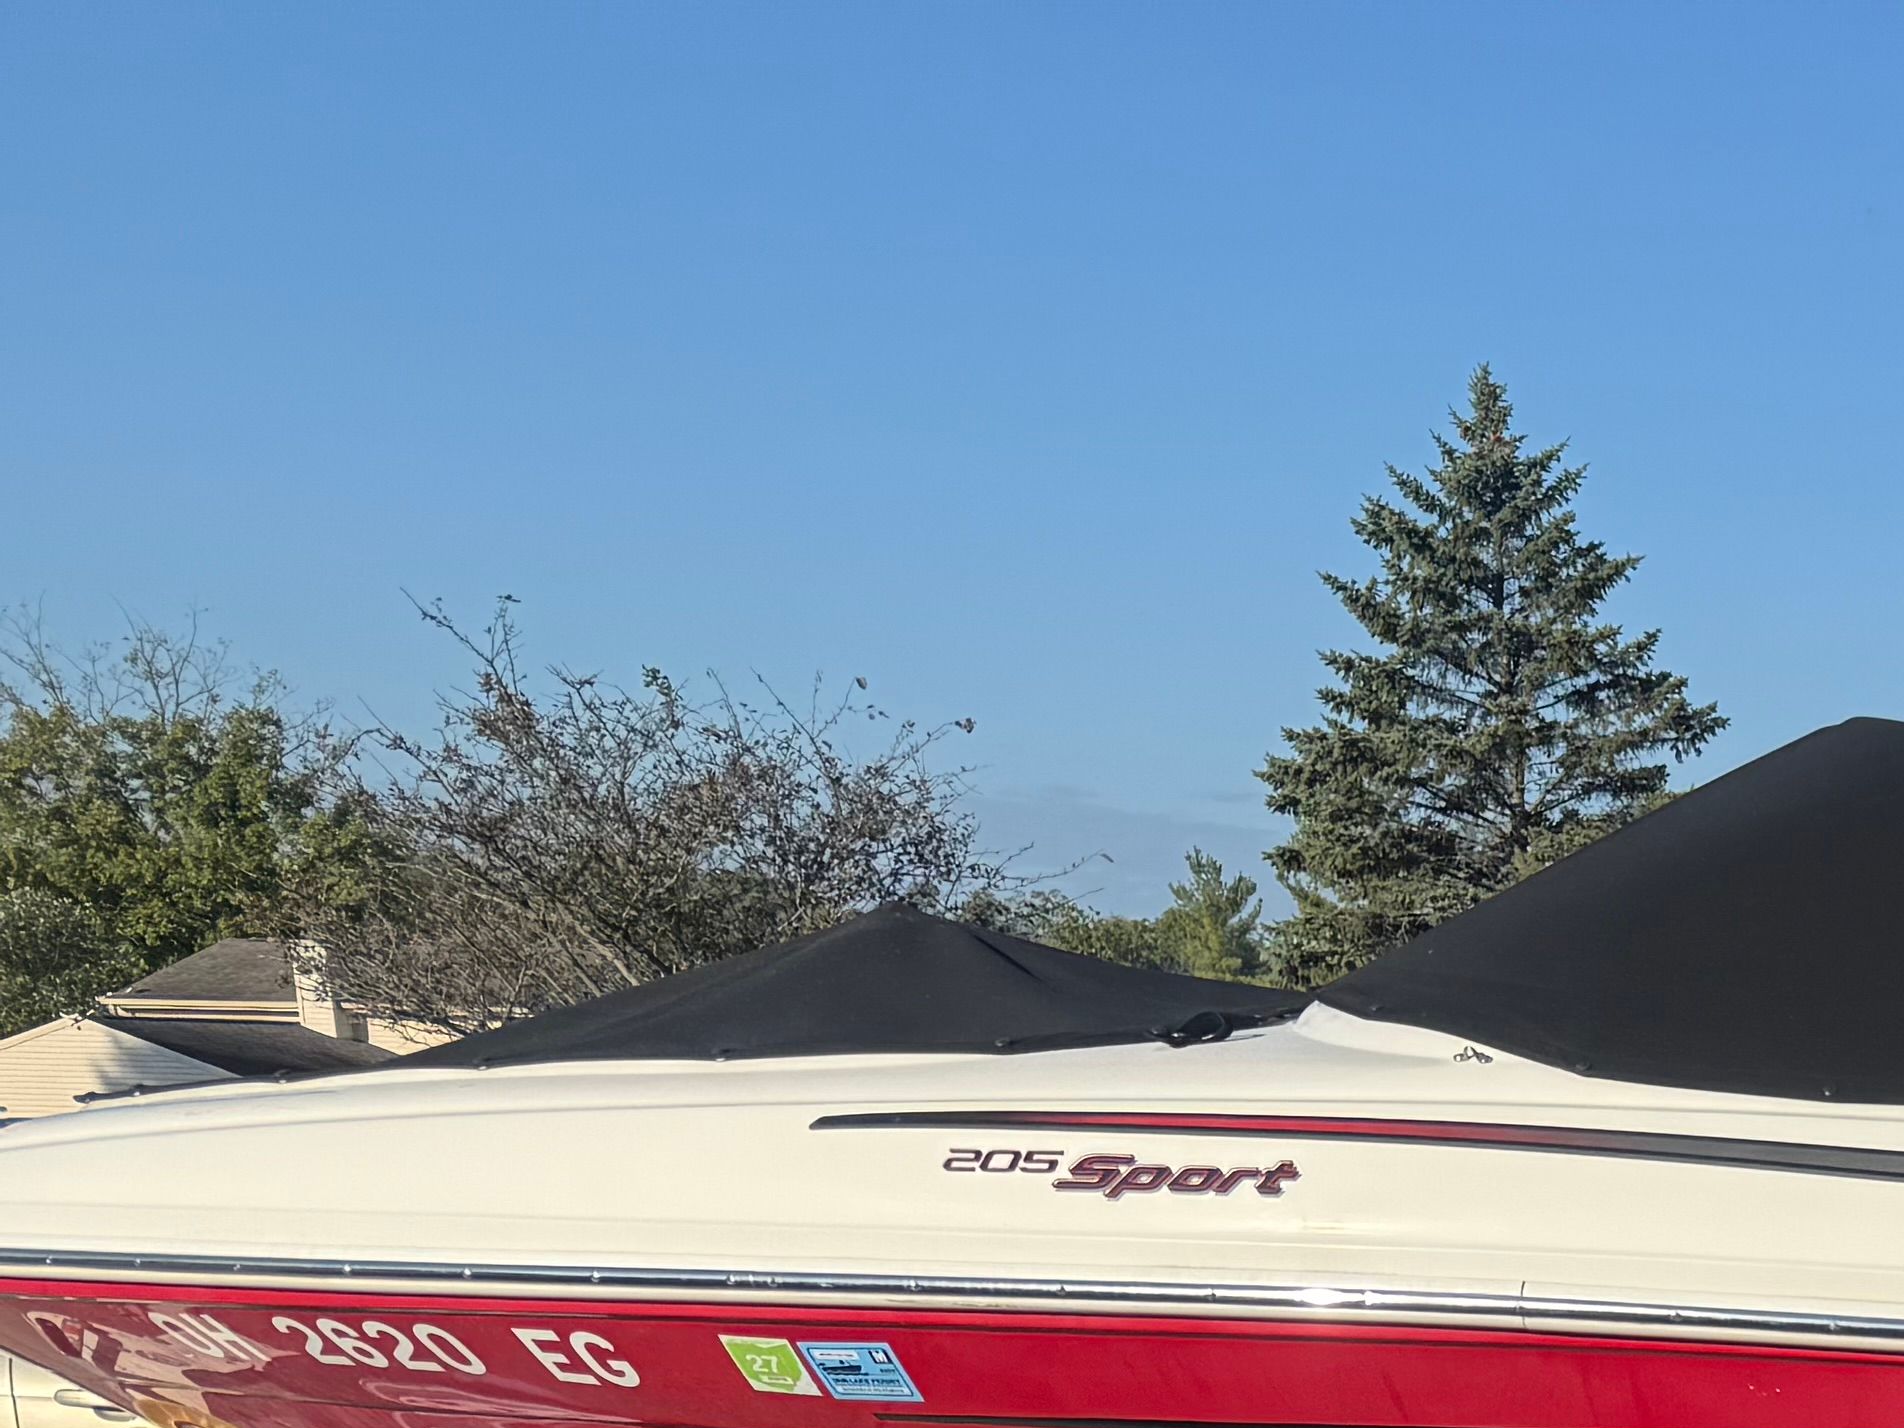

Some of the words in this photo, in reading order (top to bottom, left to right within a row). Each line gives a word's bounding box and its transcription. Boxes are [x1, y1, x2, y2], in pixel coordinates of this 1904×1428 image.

[943, 1148, 1065, 1173] 205
[1052, 1153, 1302, 1202] Sport
[147, 1311, 273, 1362] OH
[271, 1316, 487, 1375] 2620
[510, 1327, 641, 1387] EG
[745, 1355, 778, 1373] 27
